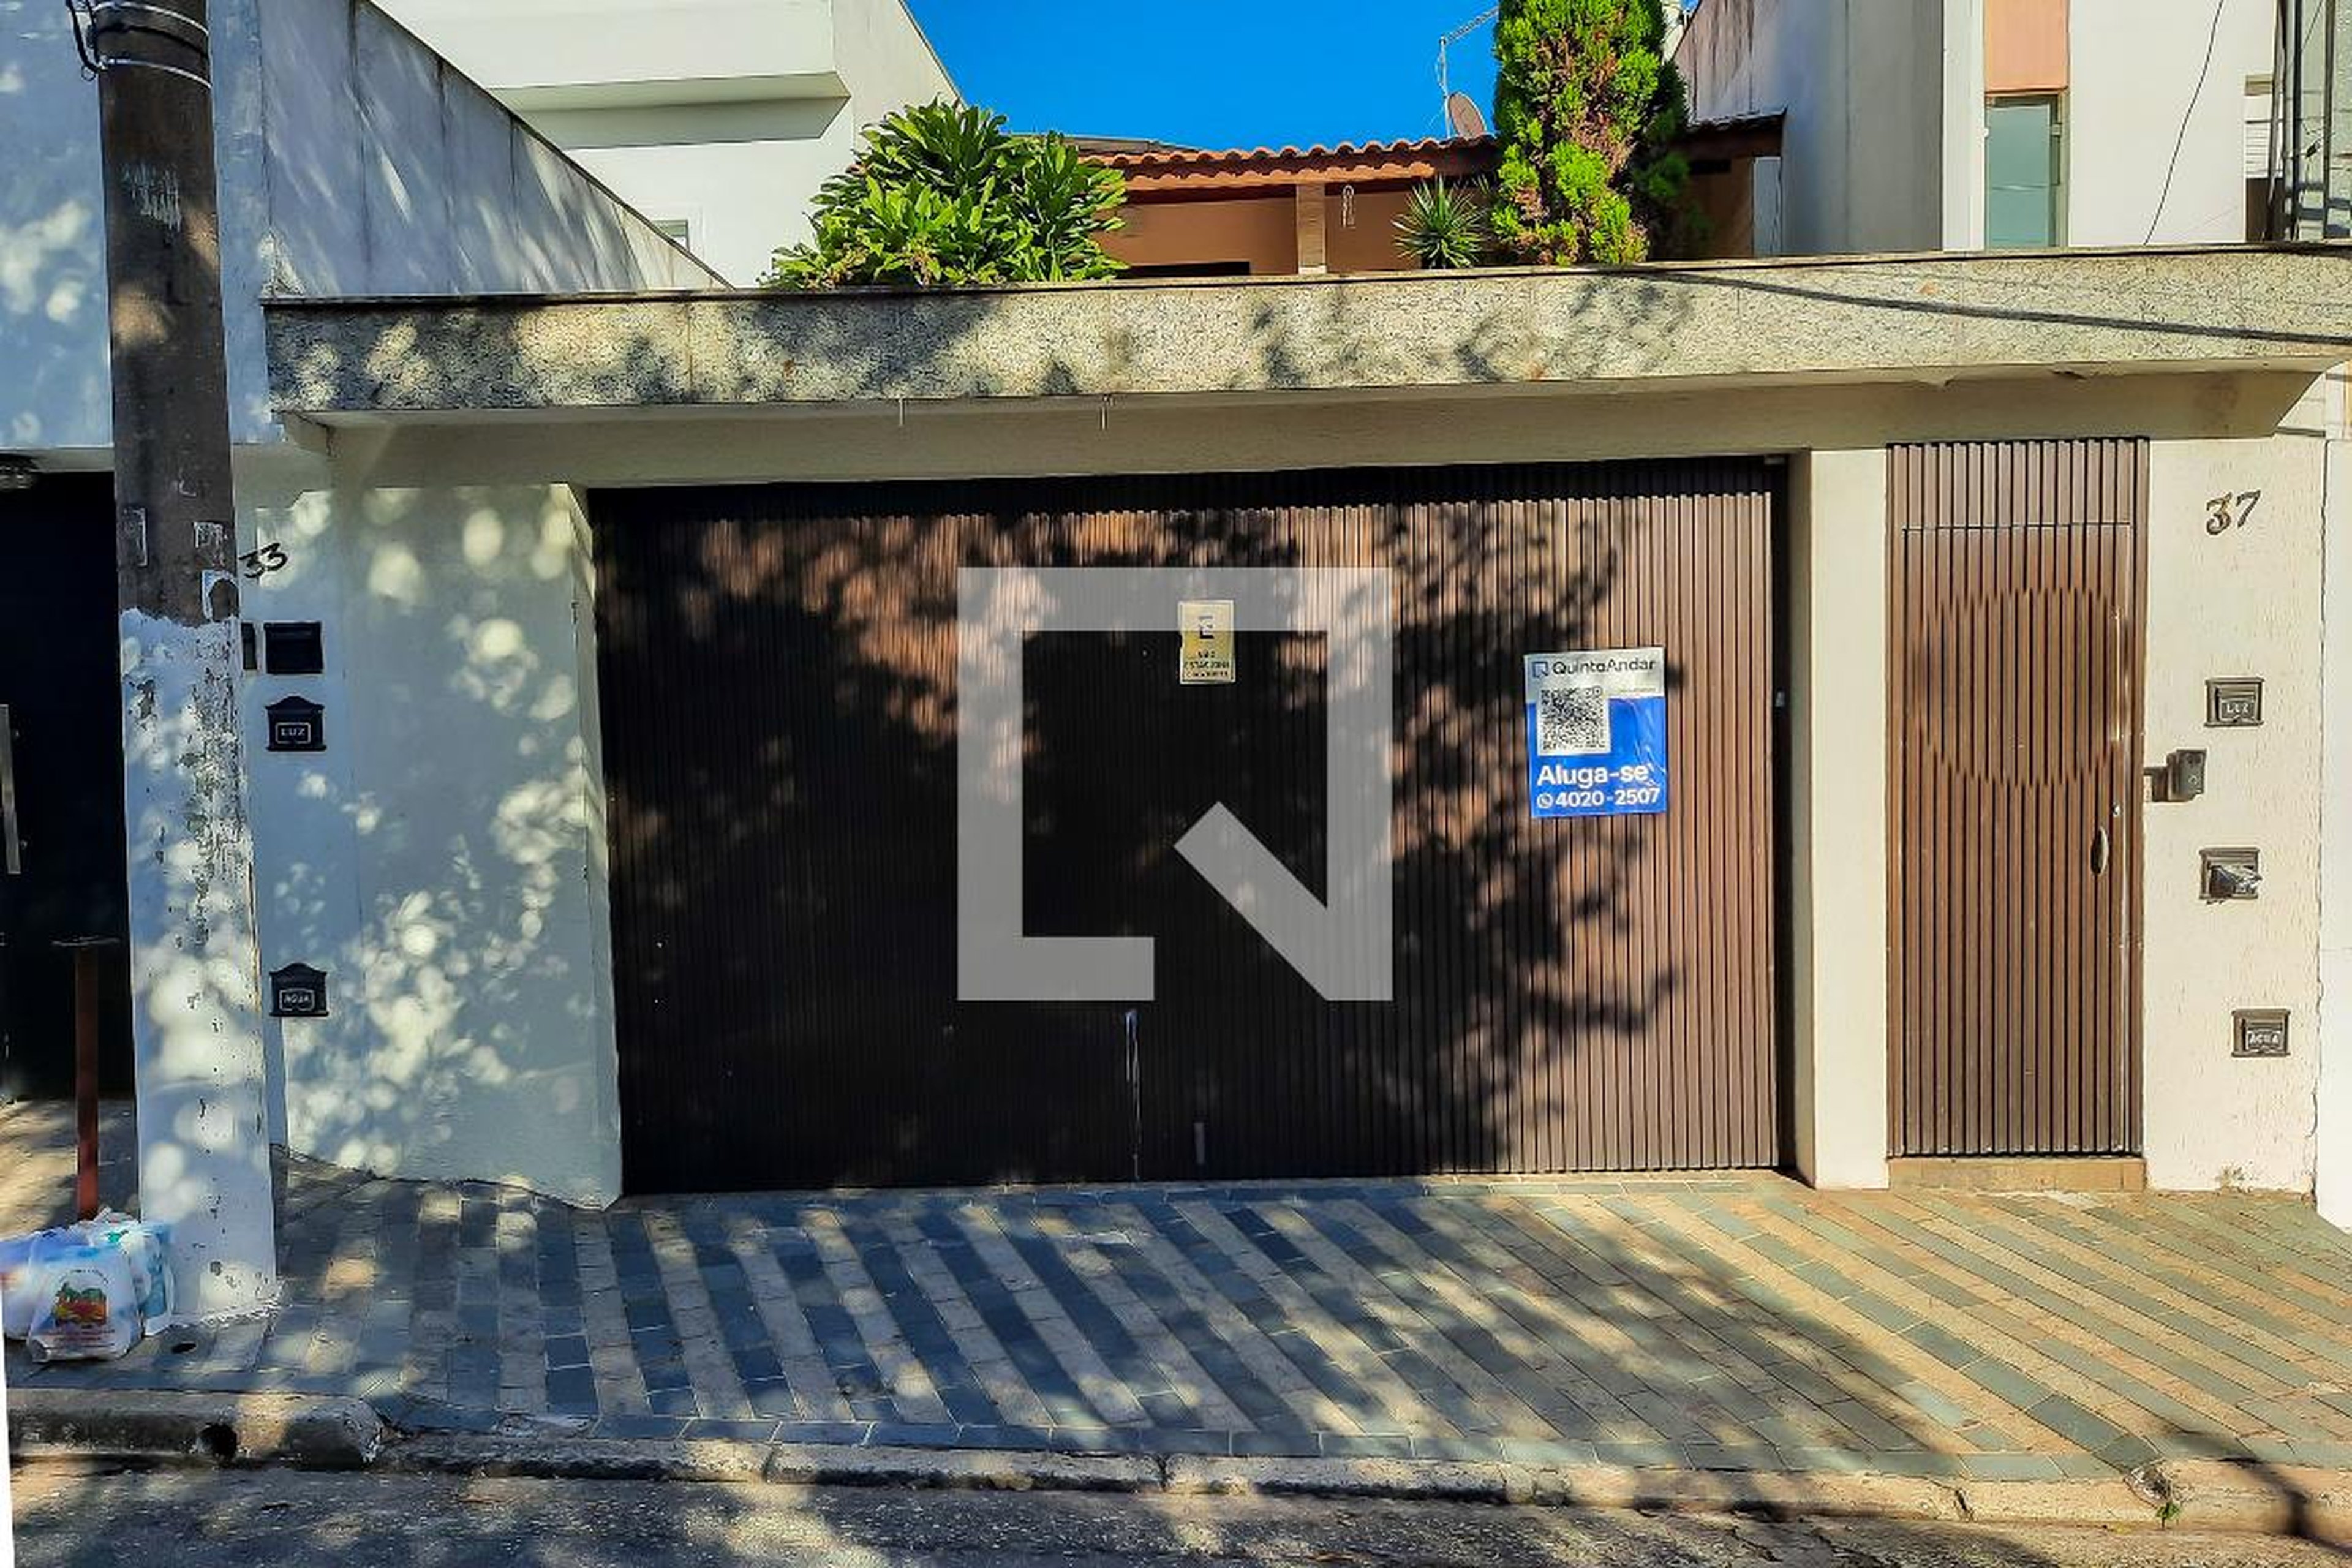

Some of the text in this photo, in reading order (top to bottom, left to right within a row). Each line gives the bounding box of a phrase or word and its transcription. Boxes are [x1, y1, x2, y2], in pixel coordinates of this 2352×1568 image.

[2206, 489, 2261, 535] 37
[238, 542, 288, 578] 33
[1552, 658, 1655, 675] QuintoAndar
[281, 727, 306, 736] LUZ
[1537, 764, 1649, 789] Aluga-se
[1556, 787, 1660, 808] 4020-2507
